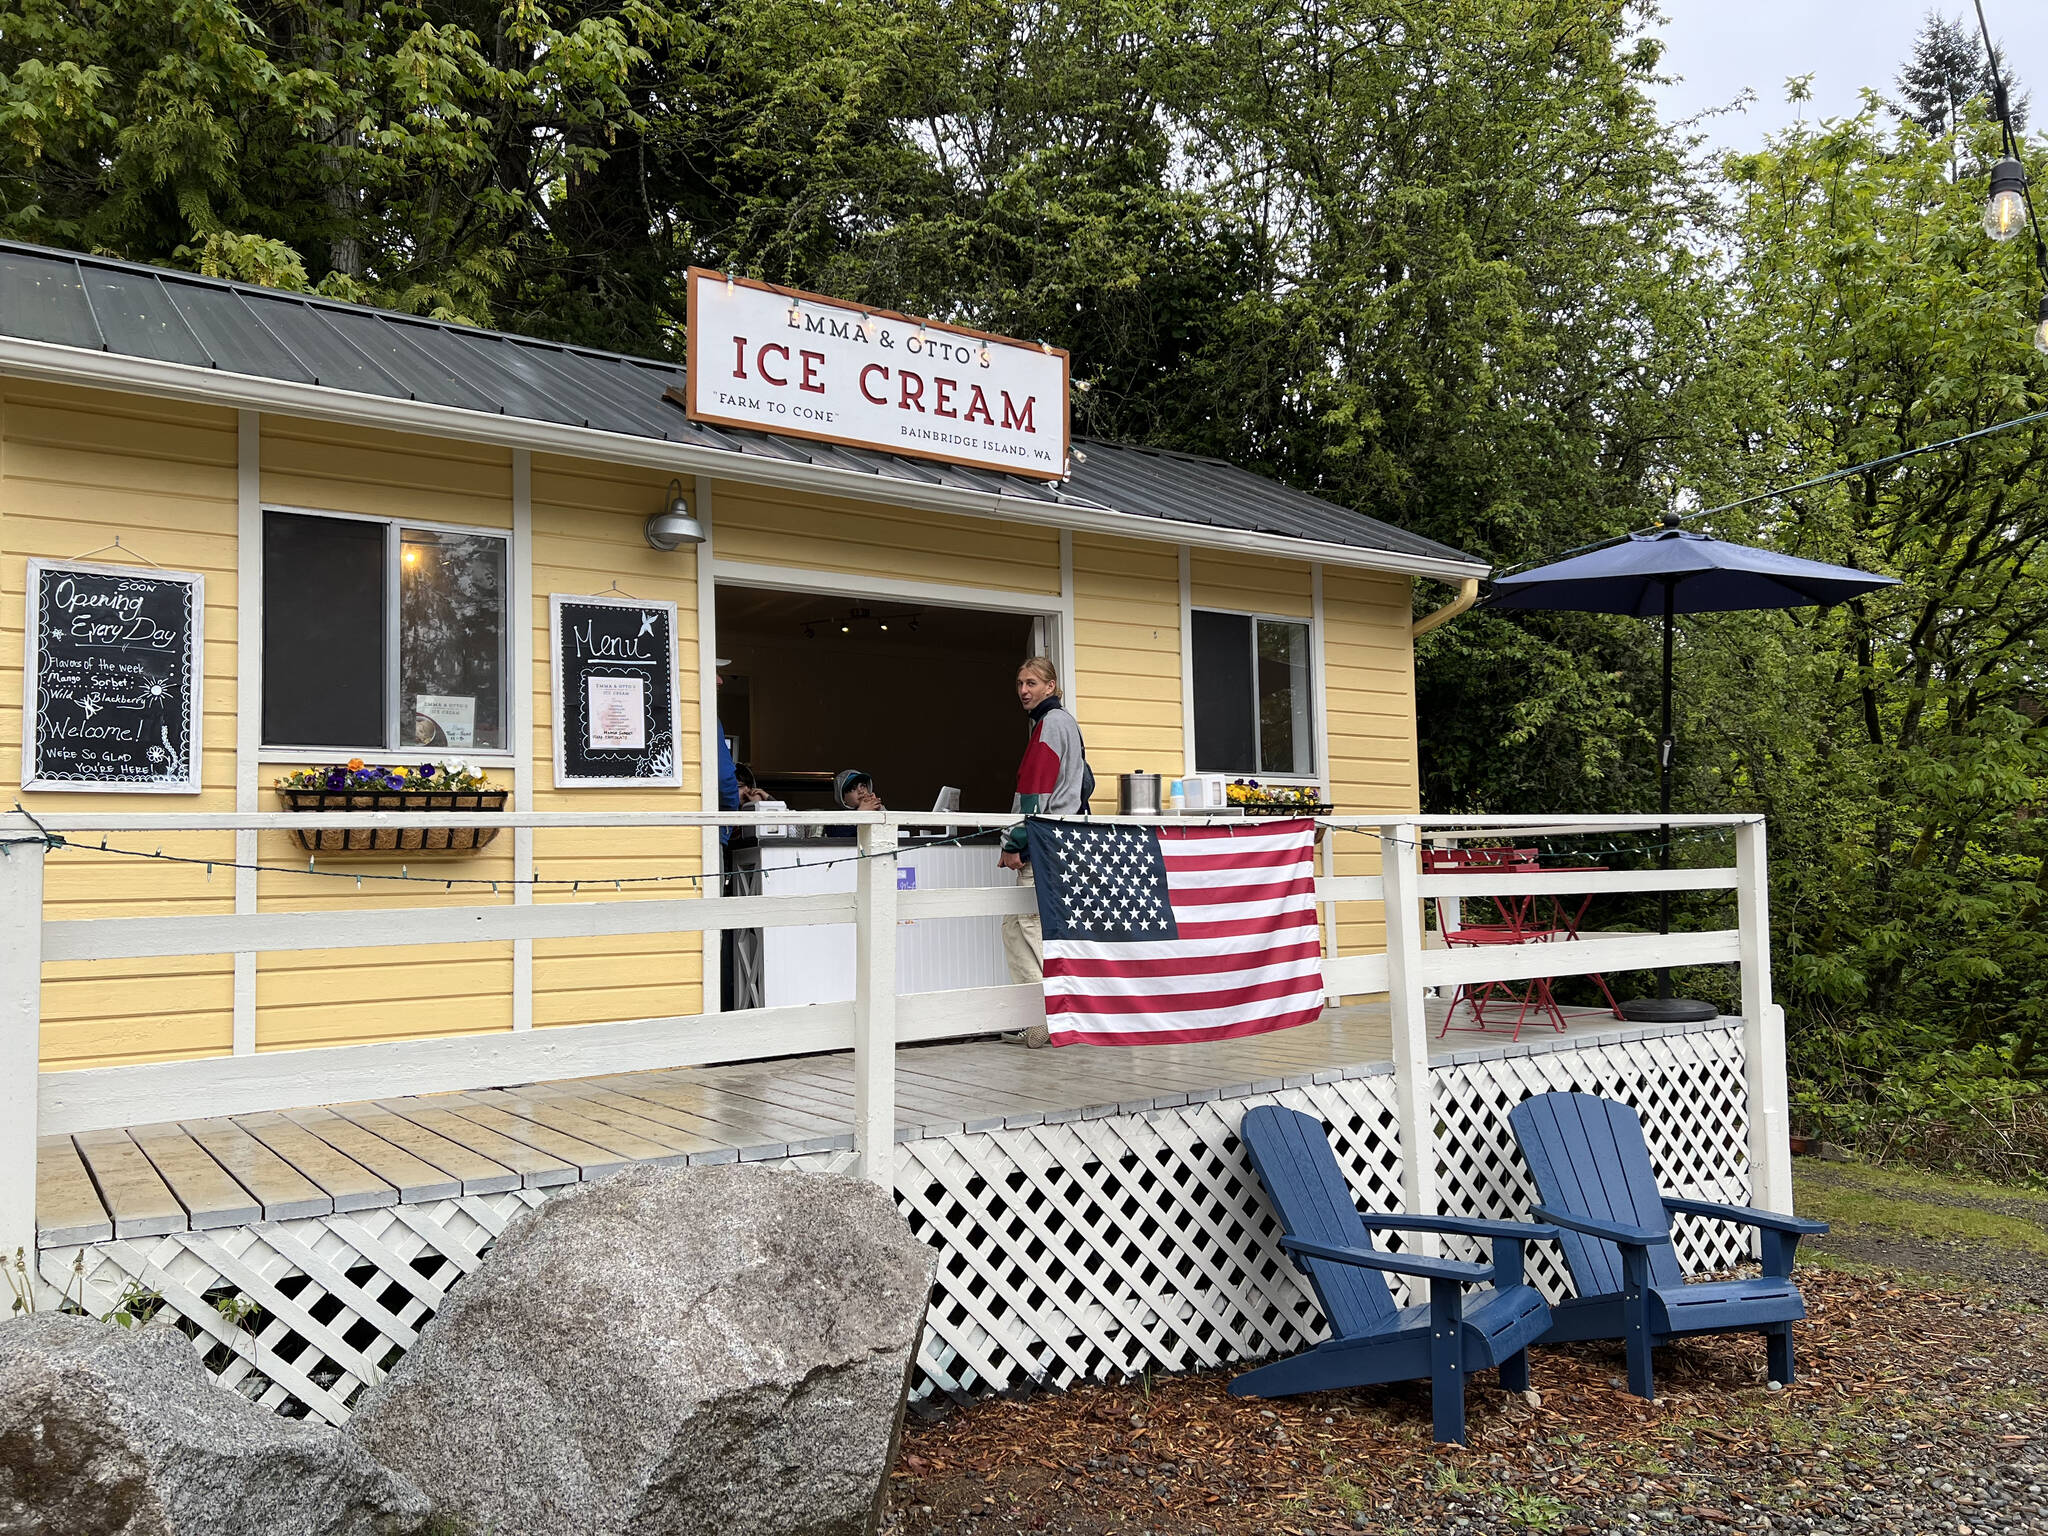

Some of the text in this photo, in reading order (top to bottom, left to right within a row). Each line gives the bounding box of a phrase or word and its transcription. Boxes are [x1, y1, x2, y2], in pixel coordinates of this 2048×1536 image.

[787, 309, 991, 369] EMMA & OTTO'S
[732, 336, 1037, 434] ICE CREAM
[767, 402, 787, 414] TO
[901, 426, 1052, 461] BAINBRIDGE ISLAND, WA
[117, 581, 157, 593] SOON
[55, 578, 144, 621] Opening
[70, 614, 177, 648] Every Day
[573, 619, 651, 658] Menu
[49, 656, 145, 674] Flavors of the week
[47, 671, 128, 688] Mango Sorbet
[50, 689, 147, 709] Wild Blackberry
[44, 716, 144, 742] Welcome!
[102, 751, 132, 762] GLAD
[121, 763, 154, 775] HERE!
